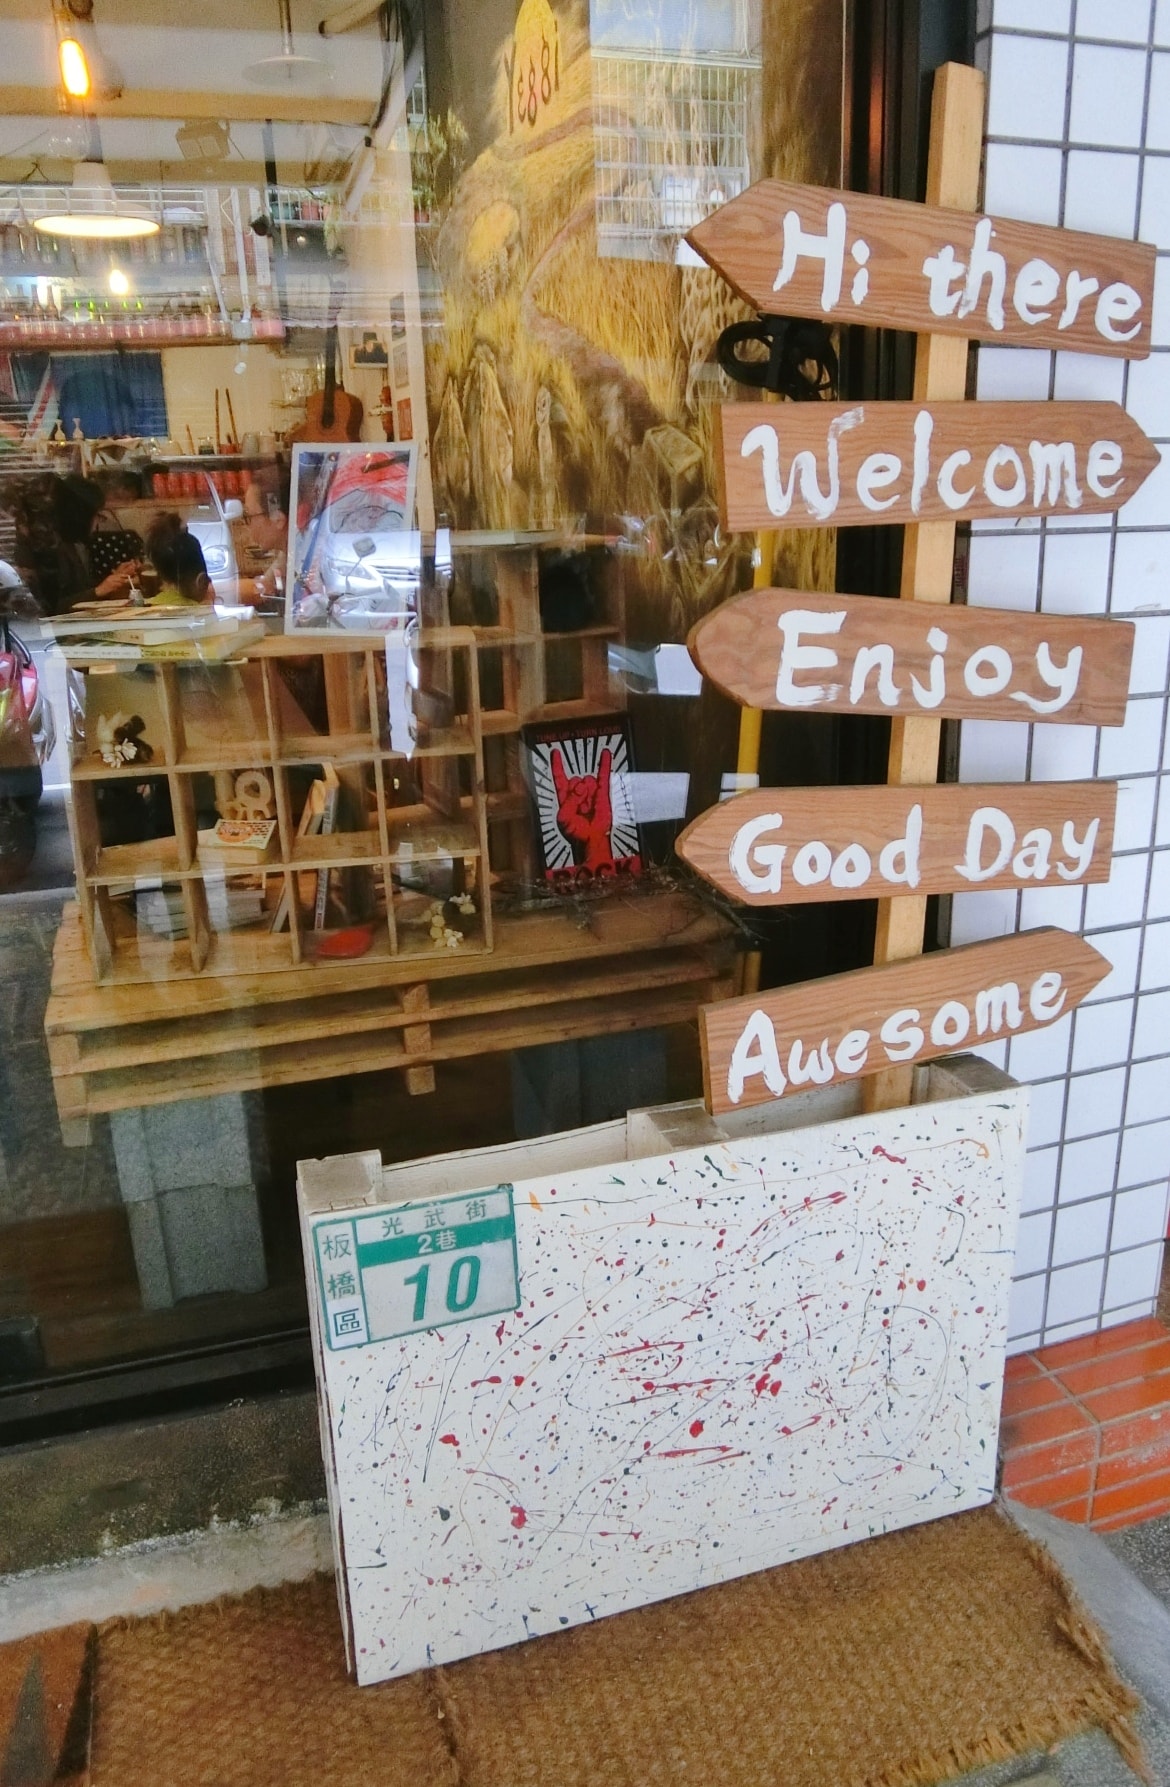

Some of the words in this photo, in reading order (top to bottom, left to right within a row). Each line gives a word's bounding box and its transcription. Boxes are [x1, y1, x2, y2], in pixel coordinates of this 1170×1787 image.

[772, 202, 870, 312] Hi
[922, 217, 1142, 342] there
[740, 406, 1125, 521] Welcome
[775, 609, 1083, 714] Enjoy
[728, 804, 923, 894] Good
[953, 806, 1101, 882] Day
[727, 971, 1067, 1104] Awesome
[381, 1198, 487, 1238] 光武街
[417, 1230, 457, 1255] 2巷
[322, 1233, 363, 1338] 板橋區
[403, 1255, 481, 1323] 10
